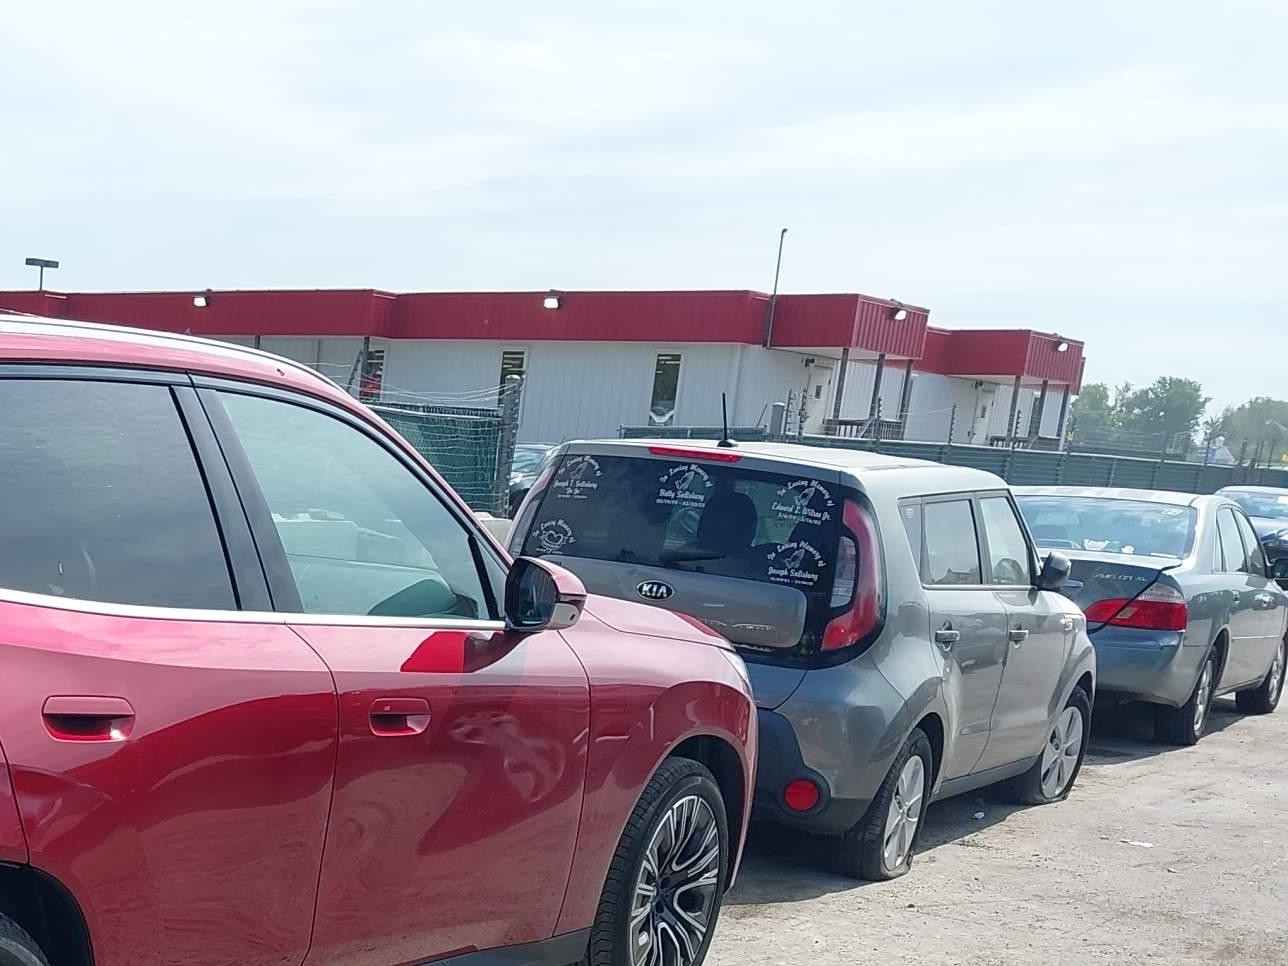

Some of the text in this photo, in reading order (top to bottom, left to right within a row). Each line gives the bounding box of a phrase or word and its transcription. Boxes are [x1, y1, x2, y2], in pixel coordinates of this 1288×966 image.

[669, 464, 689, 477] Loving
[690, 463, 709, 481] Memory
[659, 488, 705, 503] Betty Salisbury
[787, 480, 808, 490] Loving
[810, 480, 831, 500] Memory
[771, 501, 794, 512] Edward
[776, 542, 798, 553] Loving
[799, 540, 822, 560] Memory
[767, 566, 789, 577] Joseph
[789, 568, 819, 582] Salisbury
[640, 583, 669, 598] KIA
